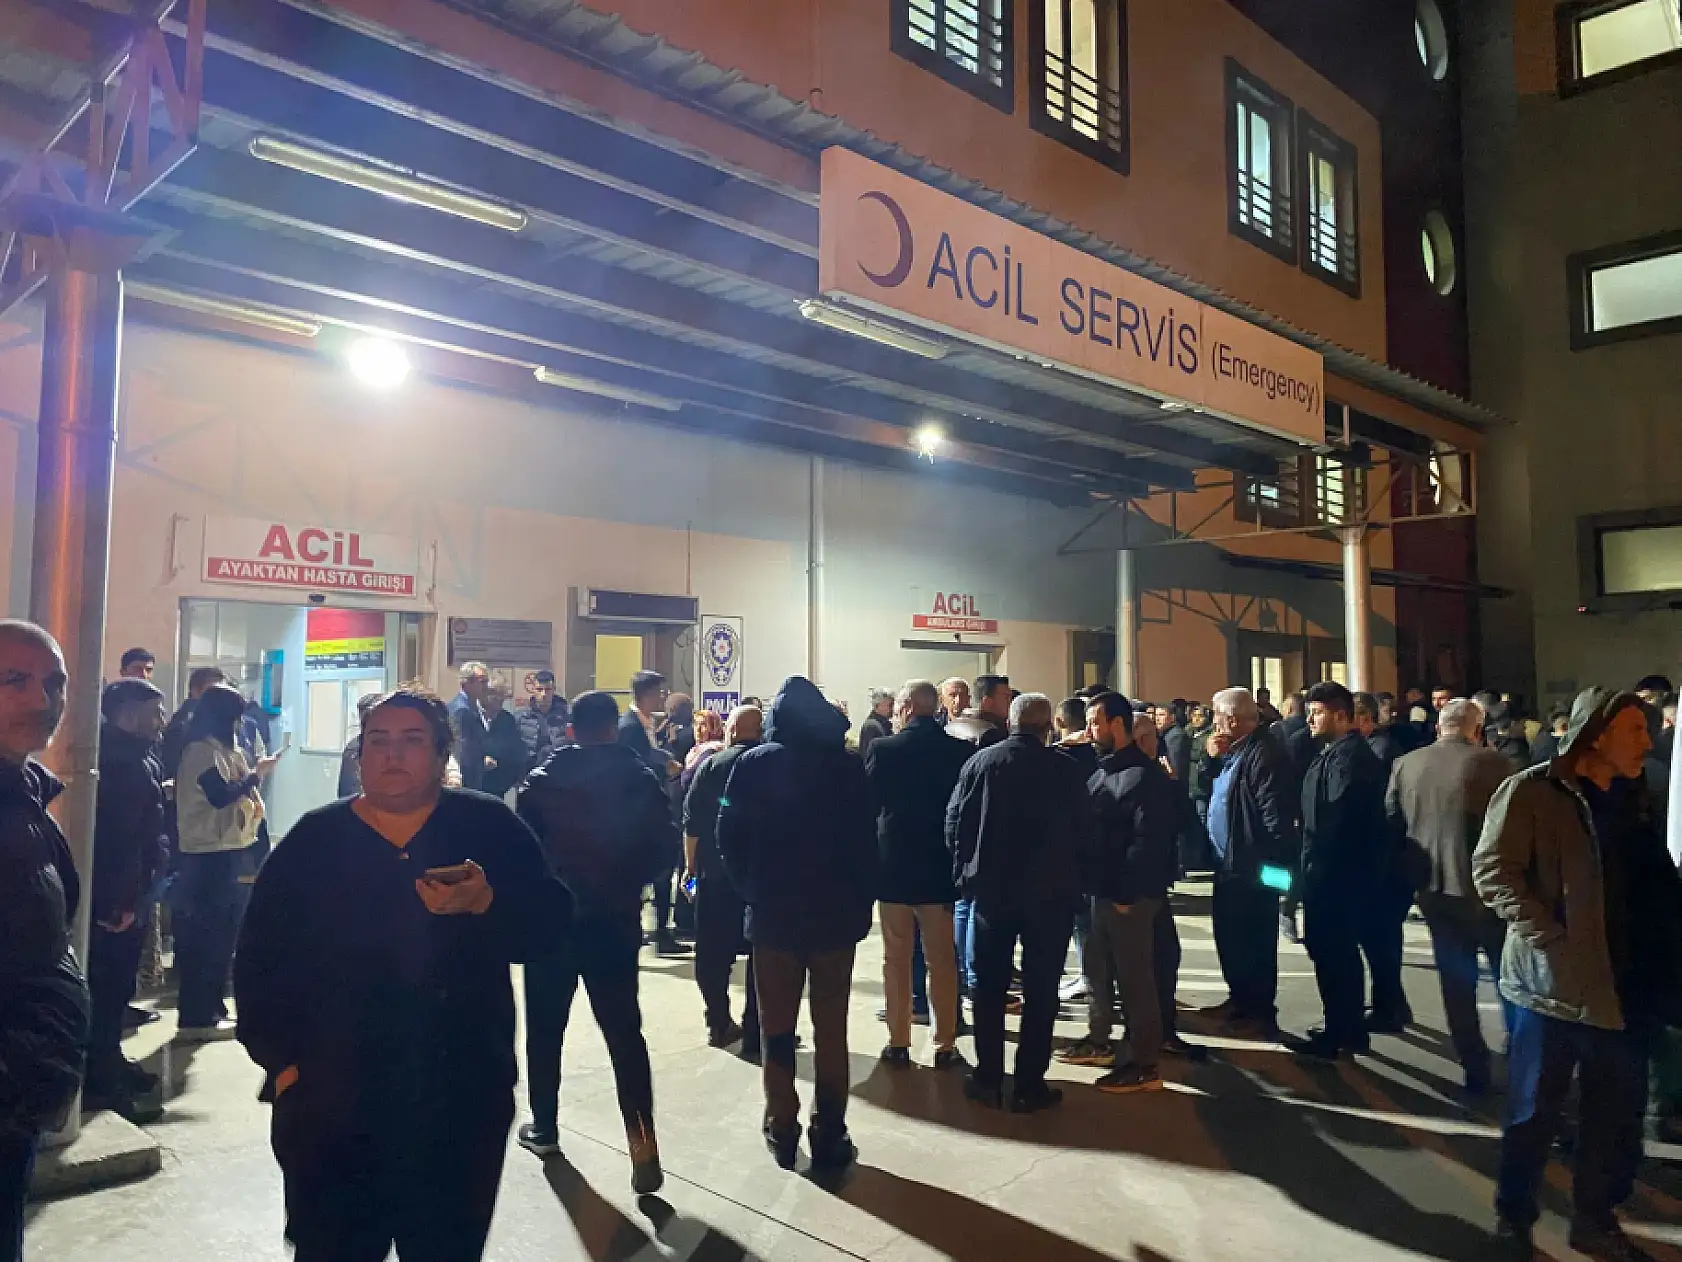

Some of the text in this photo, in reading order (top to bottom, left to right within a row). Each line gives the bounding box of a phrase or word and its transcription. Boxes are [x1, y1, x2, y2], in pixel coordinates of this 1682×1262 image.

[926, 232, 1321, 415] ACİL SERVİS (Emergency)
[217, 560, 299, 582] AYAKTAN
[303, 568, 358, 586] HASTA
